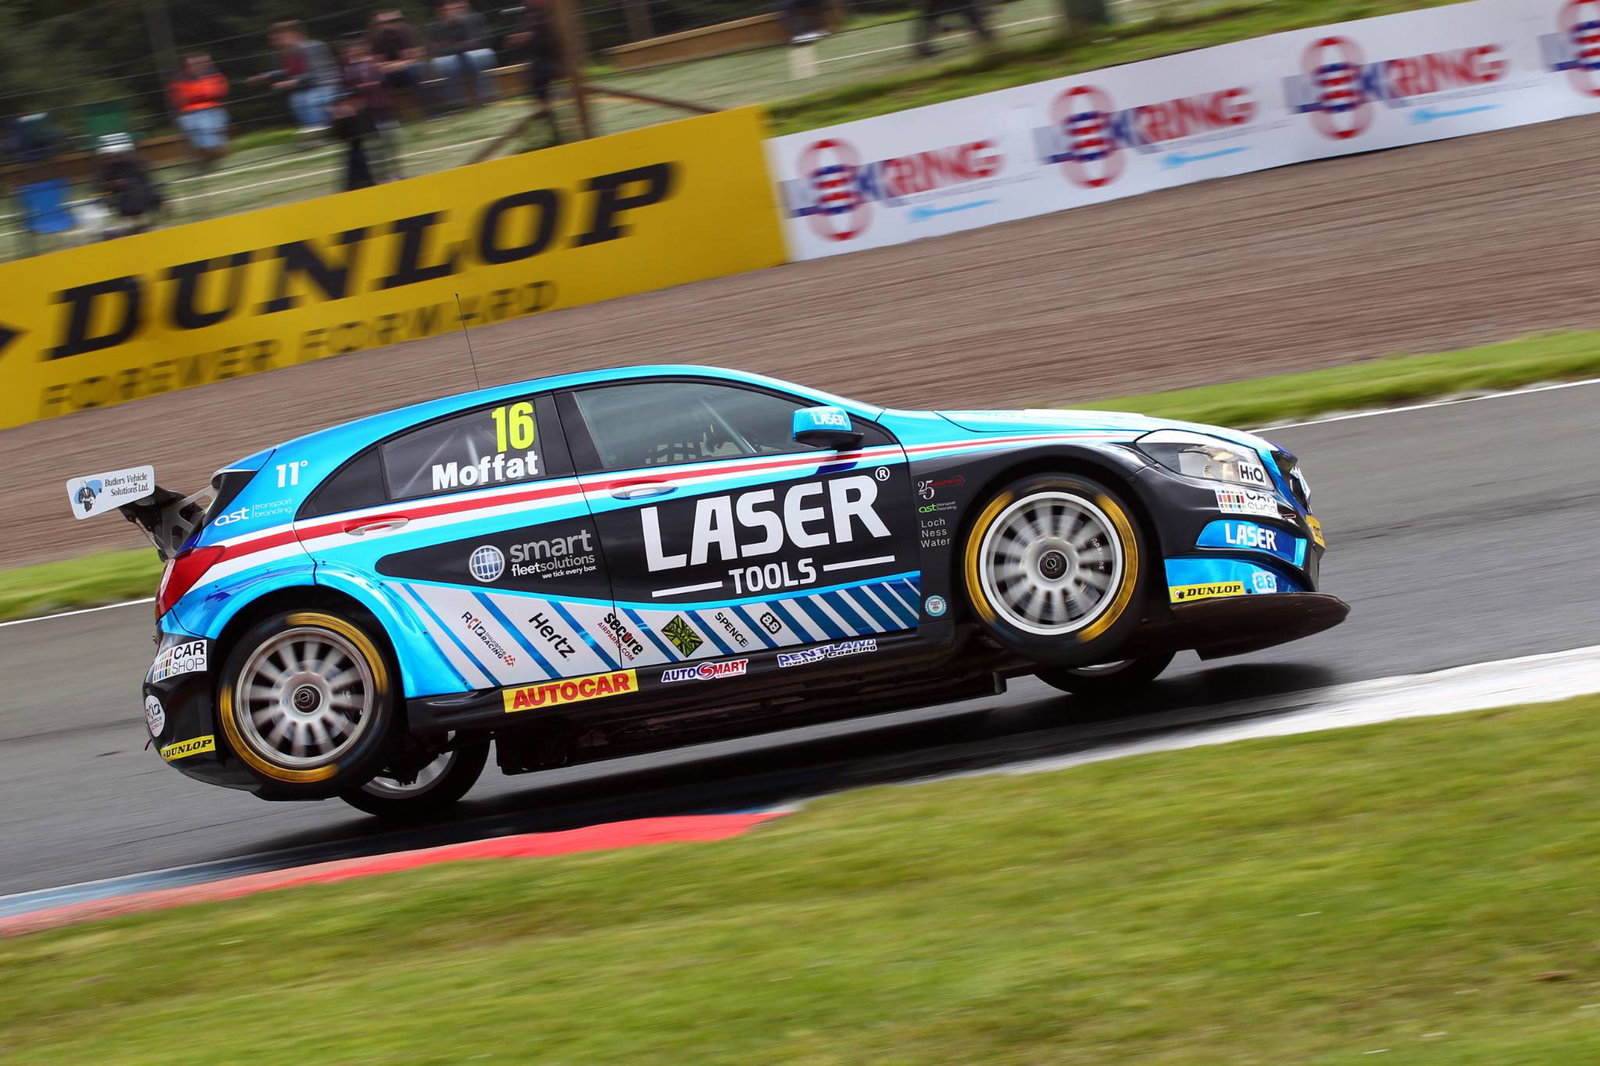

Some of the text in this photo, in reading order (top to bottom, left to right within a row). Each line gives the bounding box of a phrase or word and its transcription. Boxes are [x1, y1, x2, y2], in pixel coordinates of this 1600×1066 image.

[40, 161, 686, 361] DUNLOP
[300, 280, 559, 361] FORWARD
[492, 401, 535, 452] 16
[812, 412, 847, 425] LASER
[432, 450, 538, 490] Moffat
[1239, 465, 1265, 483] HiQ
[214, 507, 250, 526] ast
[921, 518, 946, 528] Loch
[920, 539, 951, 549] Water
[921, 529, 947, 538] Ness
[1225, 523, 1277, 551] LASER
[509, 529, 593, 563] smart
[511, 555, 596, 577] fleetsolutions
[565, 567, 583, 575] every
[729, 557, 817, 594] TOOLS
[1186, 585, 1241, 597] DUNLOP
[528, 612, 576, 659] Hertz
[603, 612, 644, 656] secure
[714, 612, 748, 647] SPENCE
[173, 641, 205, 660] CAR
[778, 639, 876, 667] PENTLAND
[827, 645, 877, 658] Coating
[172, 658, 205, 675] SHOP
[512, 673, 631, 709] AUTOCAR
[165, 738, 213, 759] DUNLOP
